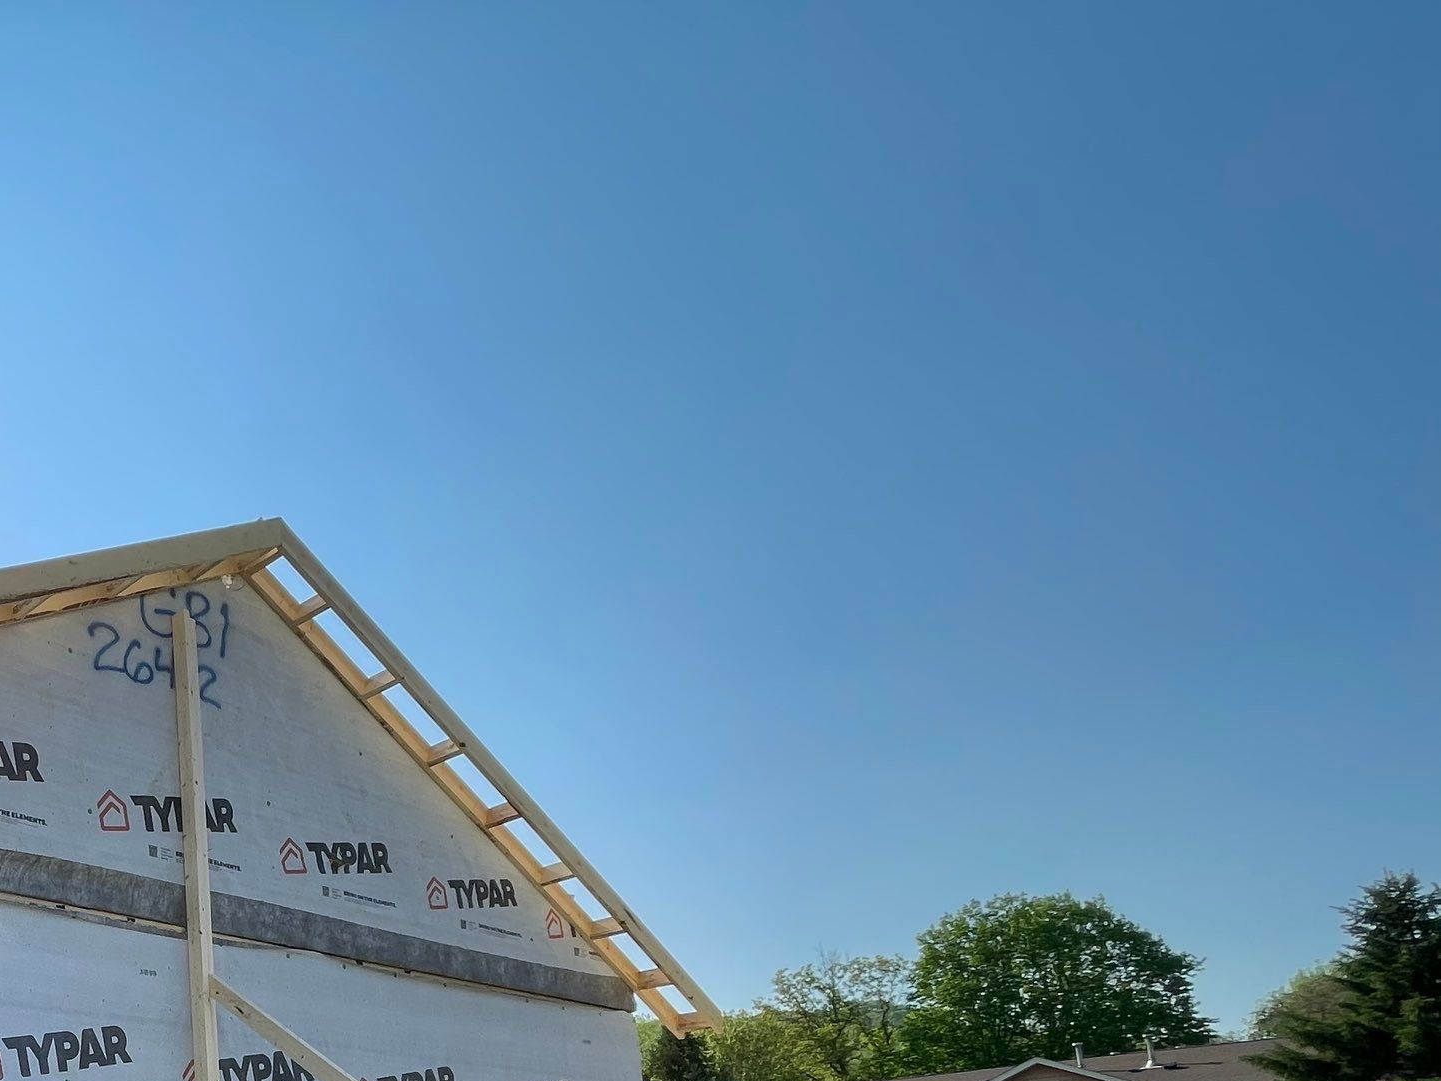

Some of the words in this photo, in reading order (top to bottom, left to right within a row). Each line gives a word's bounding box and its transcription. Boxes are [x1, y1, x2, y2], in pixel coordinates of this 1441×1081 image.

[305, 842, 392, 875] TYPAR
[447, 879, 517, 909] TYPAR
[2, 1026, 133, 1077] TYPAR
